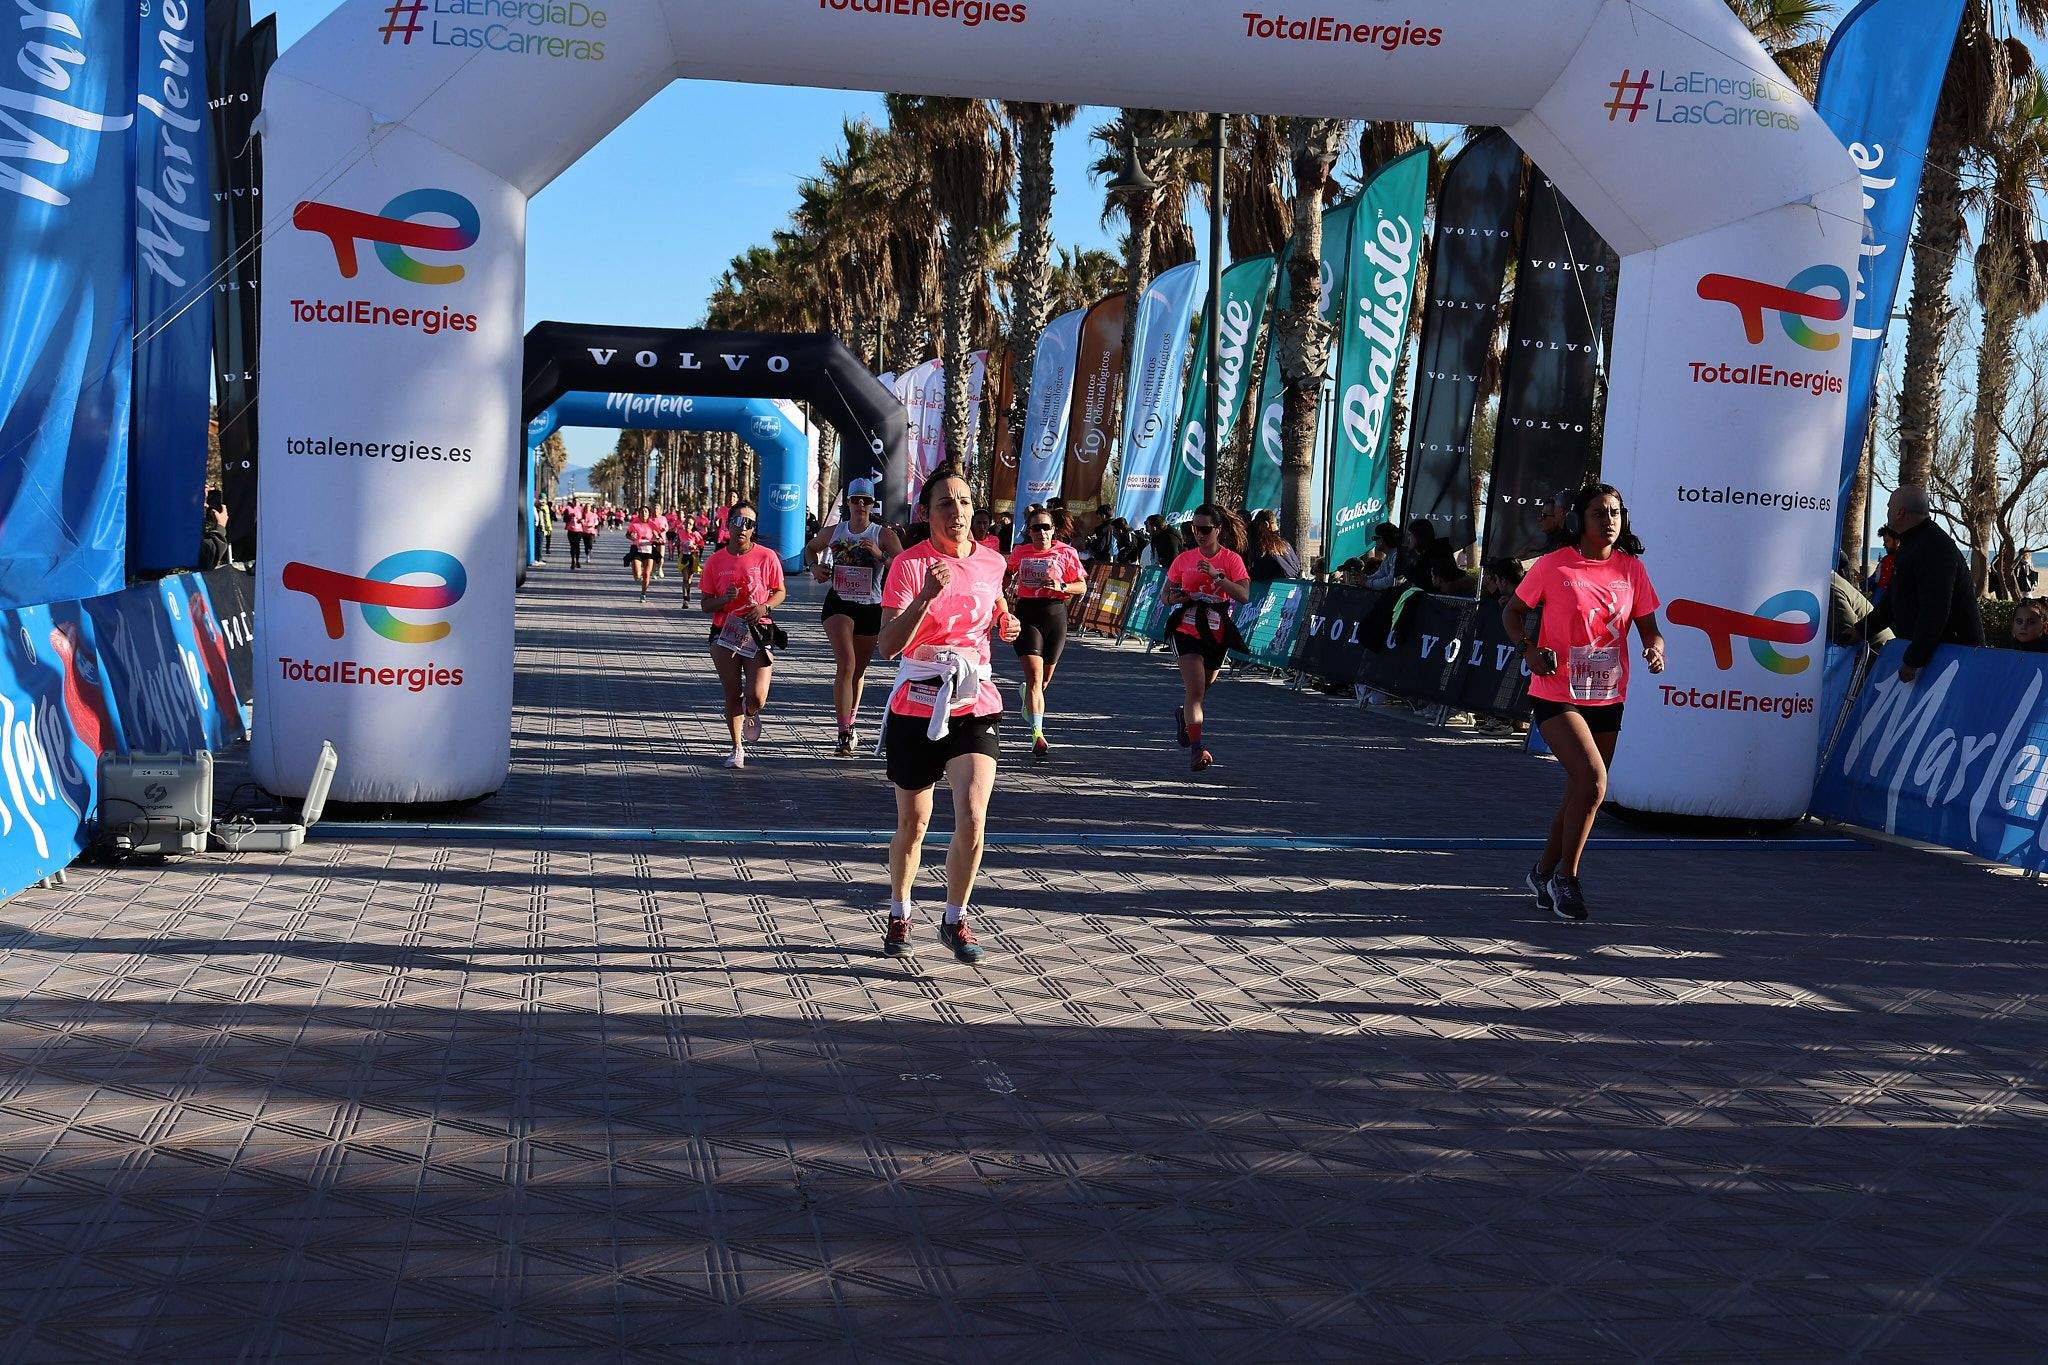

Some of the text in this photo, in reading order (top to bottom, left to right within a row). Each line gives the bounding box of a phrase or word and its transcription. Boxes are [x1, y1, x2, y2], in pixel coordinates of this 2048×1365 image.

[433, 21, 606, 61] LasCarreras
[1243, 13, 1443, 51] TotalEnergies
[1660, 70, 1792, 103] LaEnergíaDe
[1656, 99, 1800, 131] LasCarreras
[1443, 226, 1509, 238] VOLVO
[1532, 260, 1604, 273] VOLVO
[291, 298, 478, 335] TotalEnergies
[1343, 215, 1414, 459] Batiste
[1521, 339, 1592, 353] VOLVO
[587, 348, 790, 374] VOLVO
[1093, 350, 1111, 425] Odontológicos
[1143, 357, 1157, 408] Institutos
[1689, 363, 1843, 396] TotalEnergies
[606, 392, 694, 423] Marlene
[1083, 373, 1096, 423] Institutos
[1512, 418, 1583, 433] VOLVO
[287, 436, 471, 464] totalenergies.es
[1677, 485, 1831, 512] totalenergies.es
[279, 656, 463, 693] TotalEnergies
[1659, 685, 1814, 719] TotalEnergies
